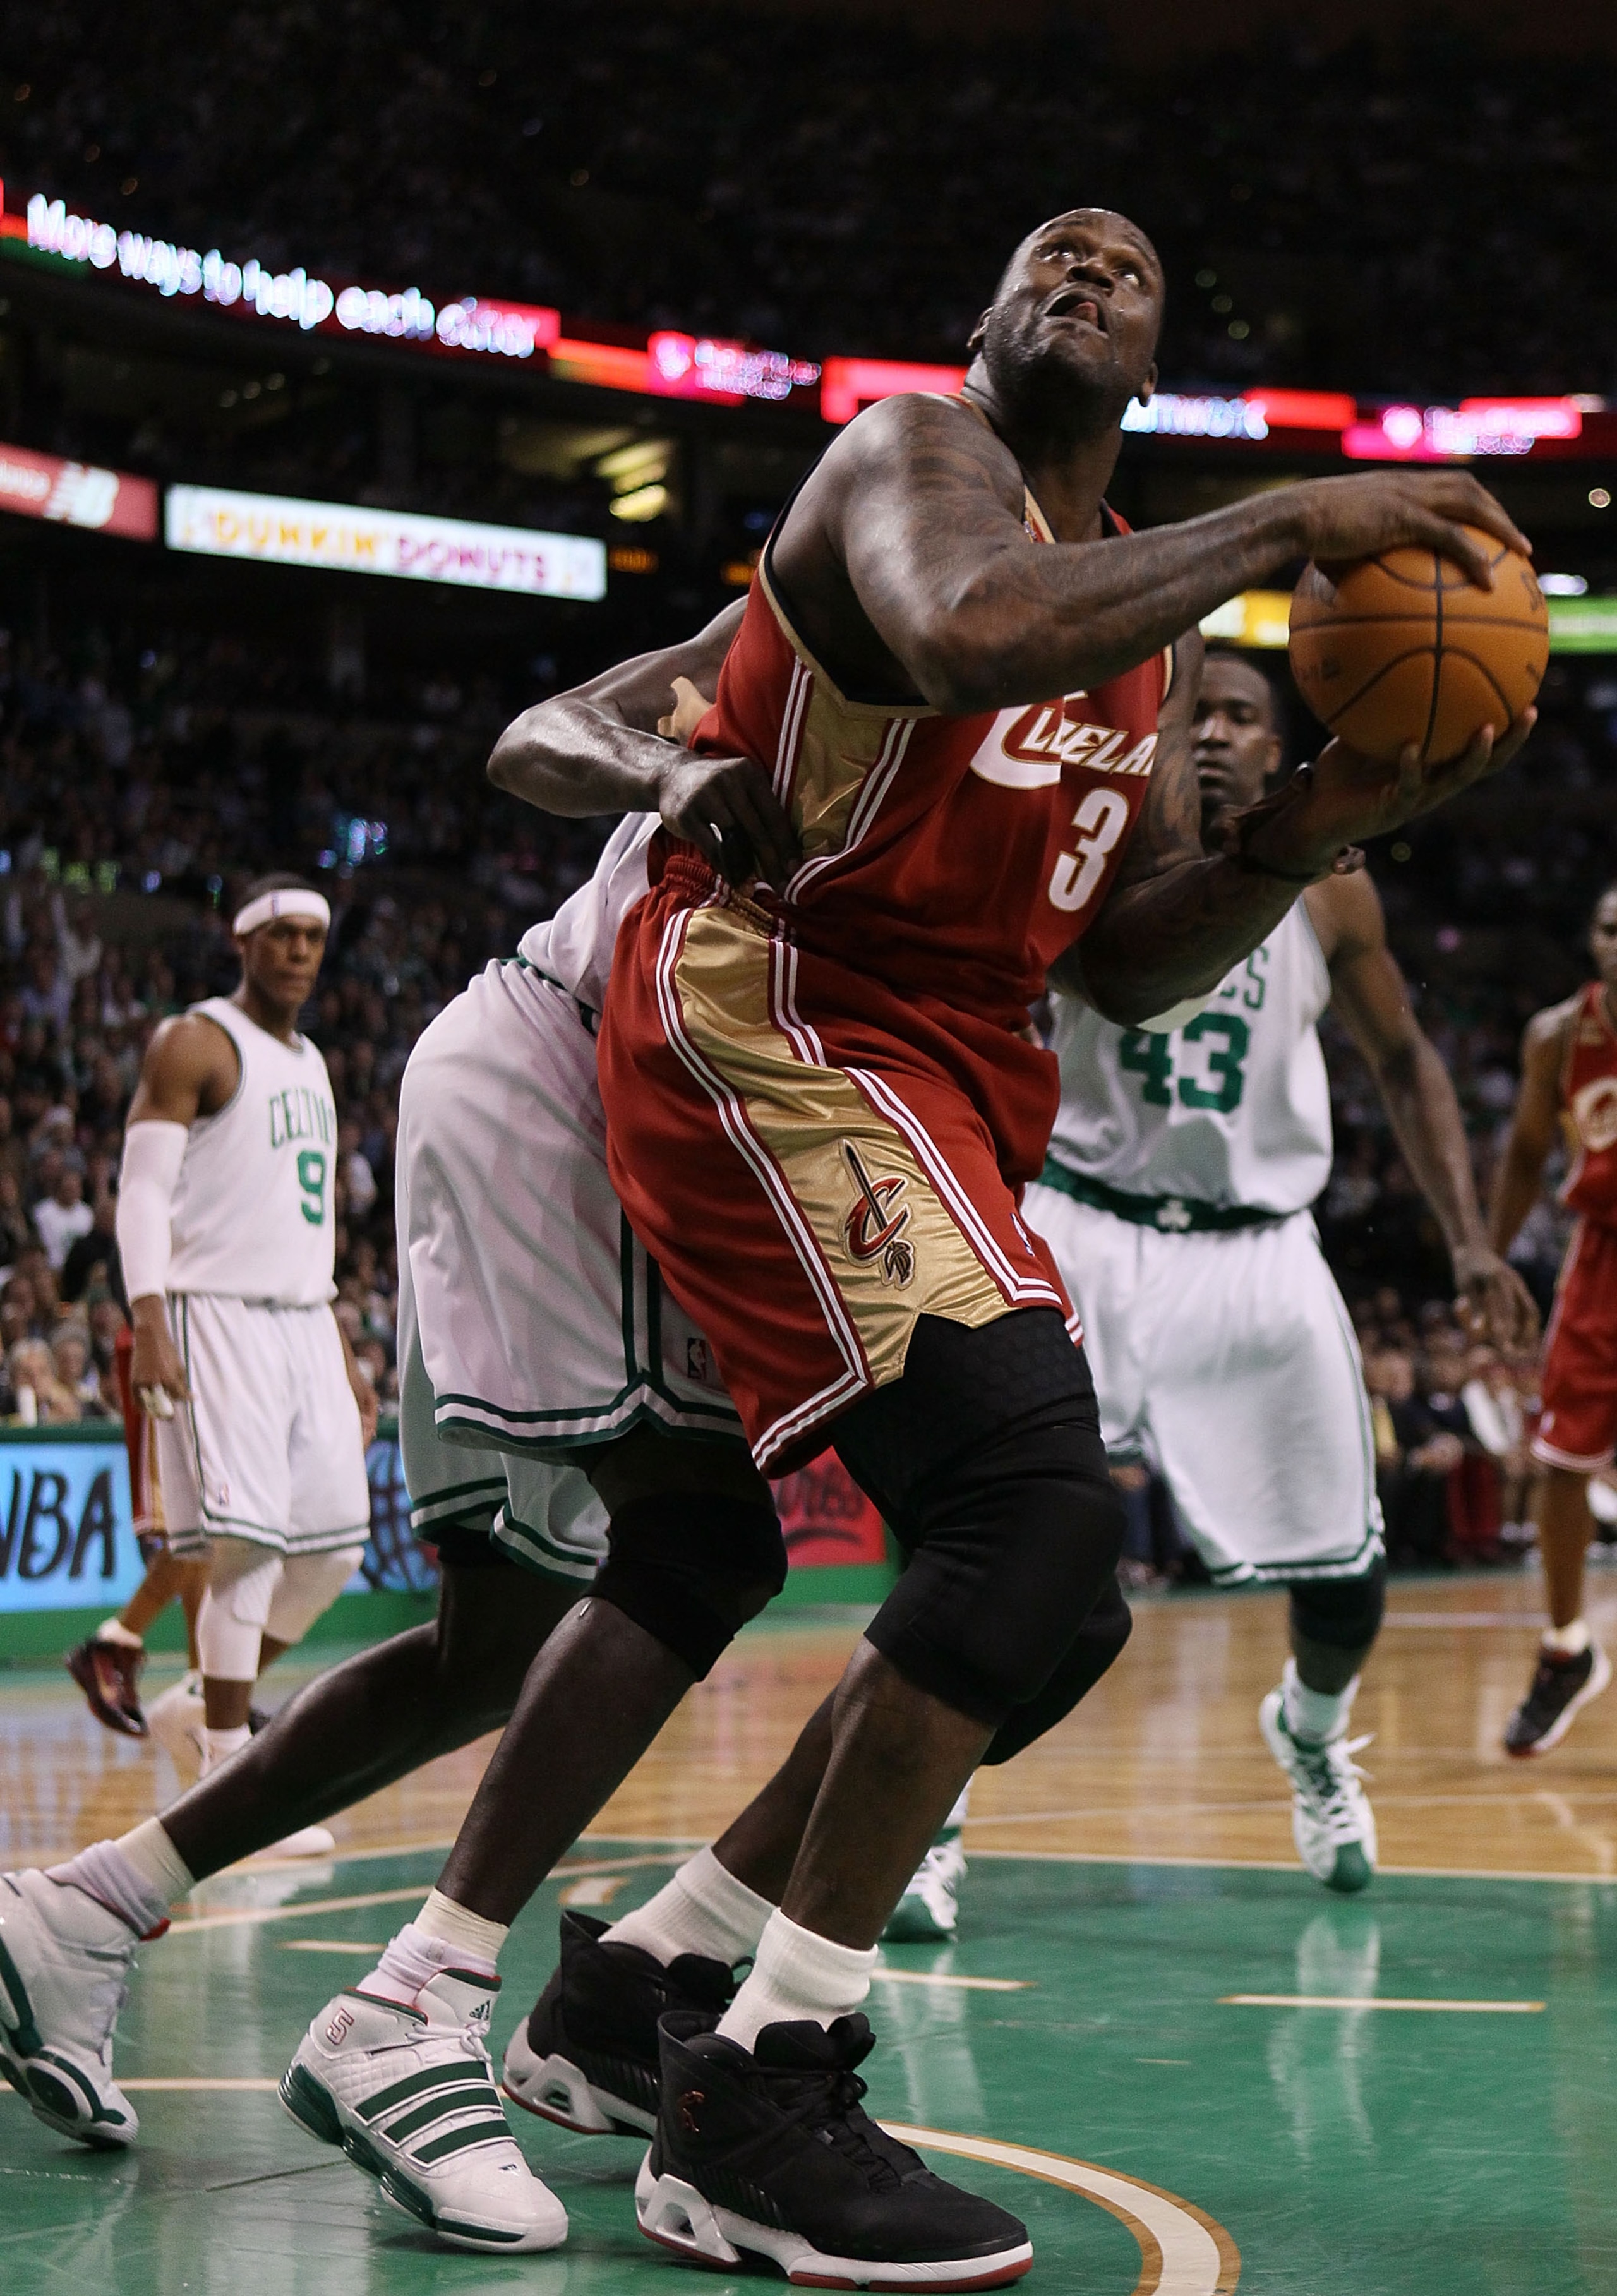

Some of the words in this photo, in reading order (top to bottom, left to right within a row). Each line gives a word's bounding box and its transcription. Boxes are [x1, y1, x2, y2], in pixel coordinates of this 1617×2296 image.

[1047, 786, 1129, 913] 3
[1119, 1012, 1251, 1114] 43
[297, 1148, 326, 1225] 9
